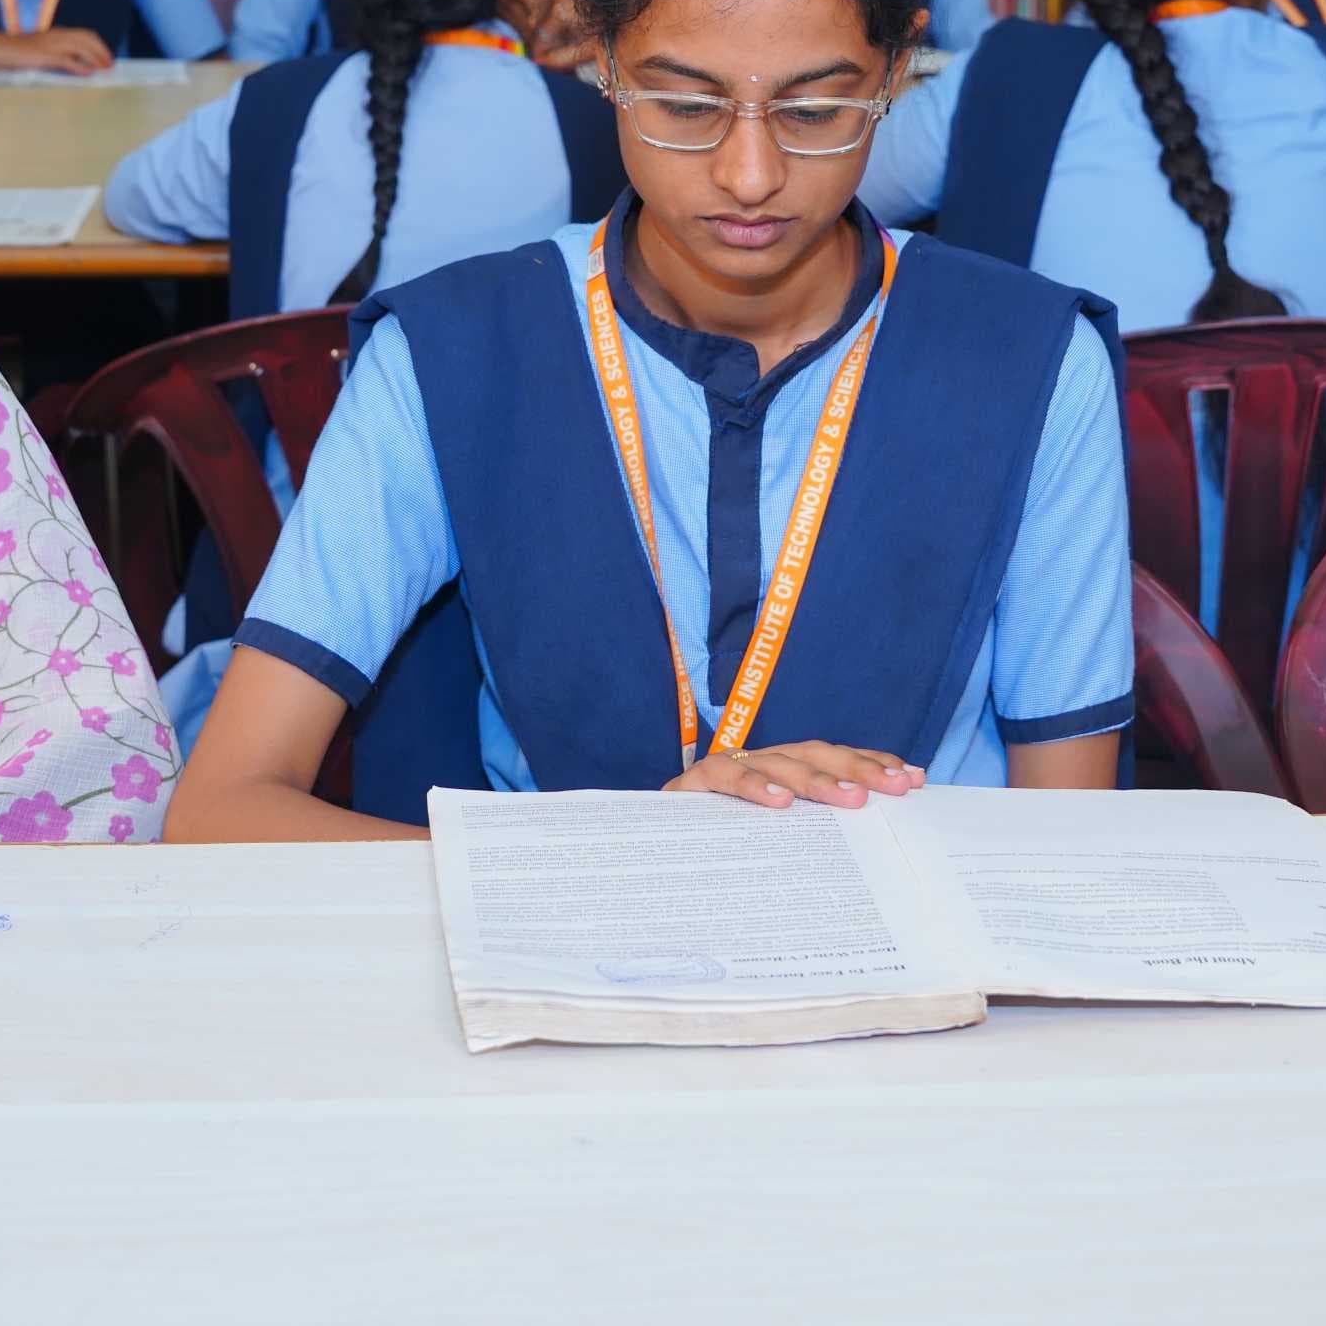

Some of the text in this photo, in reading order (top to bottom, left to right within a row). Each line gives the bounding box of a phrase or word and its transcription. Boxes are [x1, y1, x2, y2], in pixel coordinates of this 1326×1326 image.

[592, 290, 623, 382] SCIENCES
[611, 385, 627, 399] &
[822, 424, 840, 438] &
[782, 441, 835, 569] TECHNOLOGY
[774, 573, 796, 600] OF
[738, 601, 787, 701] INSTITUTE
[719, 703, 750, 750] PACE
[1140, 956, 1255, 967] About the Book
